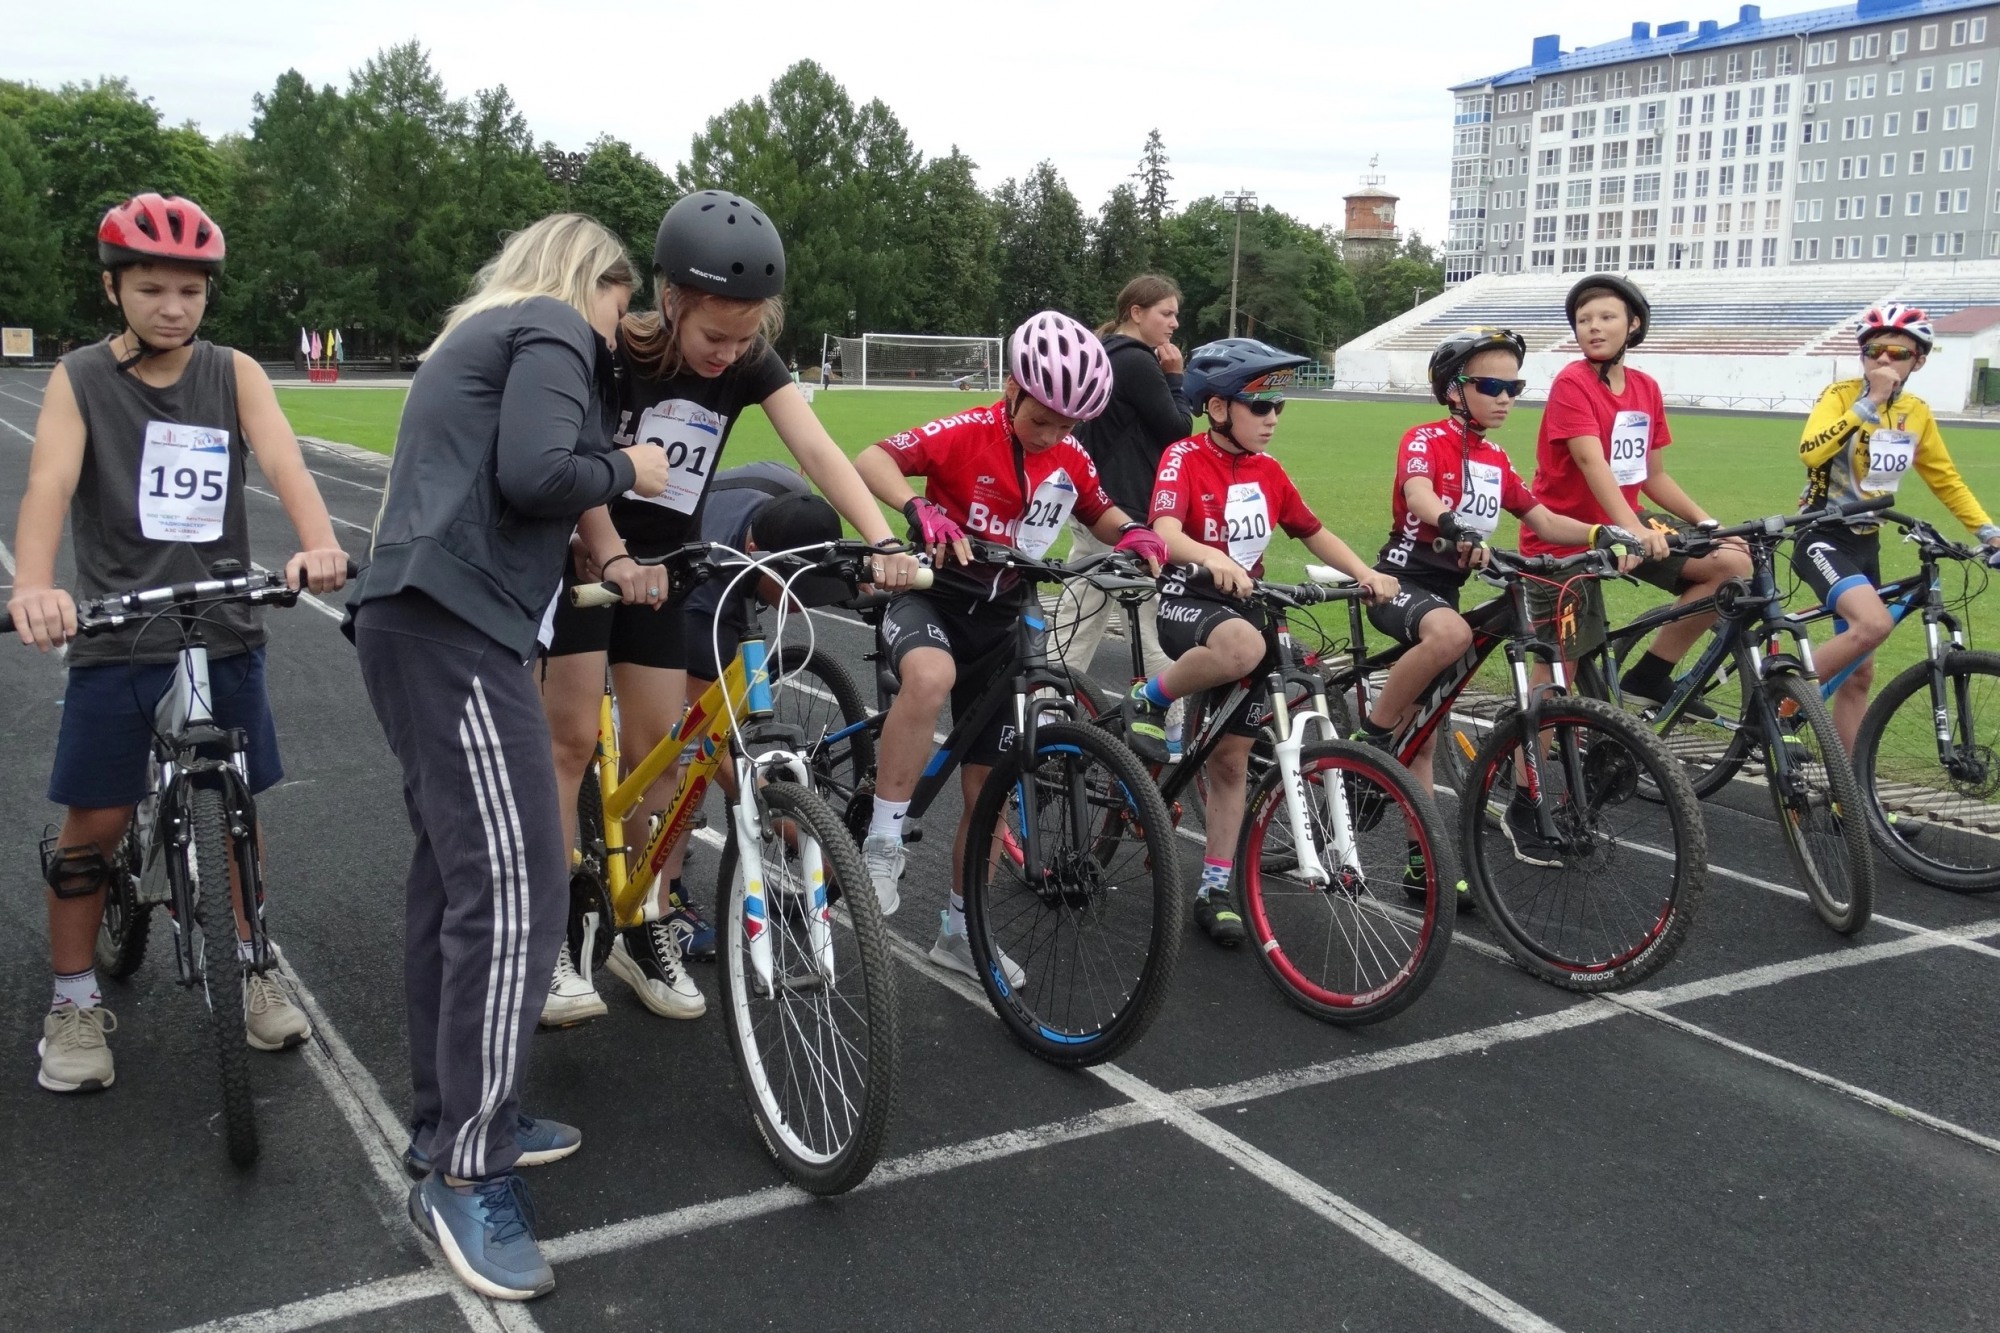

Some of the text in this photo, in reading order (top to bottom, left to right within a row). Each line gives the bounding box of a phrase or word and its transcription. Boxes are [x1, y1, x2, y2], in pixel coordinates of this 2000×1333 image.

[689, 267, 727, 283] REACTION
[1613, 438, 1645, 460] 203
[1871, 453, 1908, 472] 208
[149, 465, 223, 502] 195
[1025, 500, 1063, 528] 214
[1462, 493, 1498, 519] 209
[1229, 513, 1266, 542] 210
[1812, 549, 1841, 586] GAZPROM
[1292, 770, 1313, 841] MANITOU
[1336, 768, 1355, 842] MANITOU
[627, 773, 687, 885] FORWARD
[657, 790, 701, 865] FORWARD
[1633, 913, 1675, 967] HUTCHINSON
[1570, 970, 1614, 982] SCORPION
